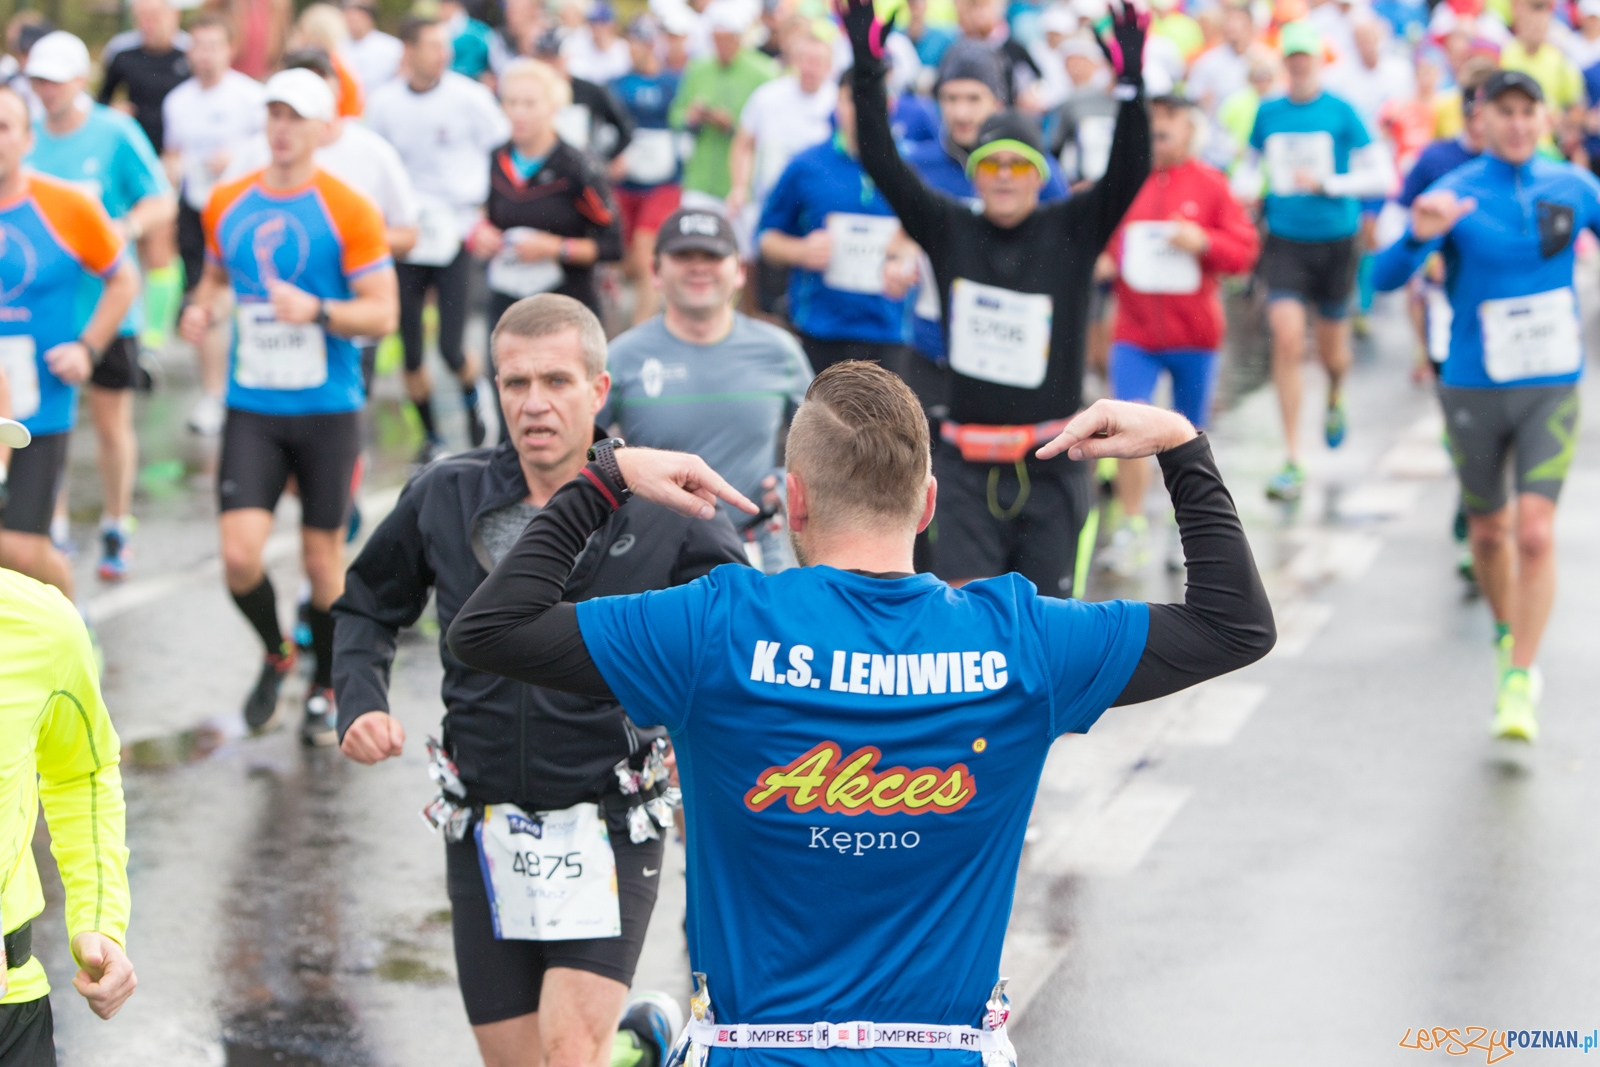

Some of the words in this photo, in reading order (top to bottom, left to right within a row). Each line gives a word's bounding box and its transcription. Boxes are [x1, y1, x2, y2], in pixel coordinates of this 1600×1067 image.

[750, 640, 820, 689] K.S.
[829, 650, 1009, 696] LENIWIEC
[748, 744, 973, 812] Akces
[808, 826, 920, 855] Kępno
[512, 851, 583, 880] 4875
